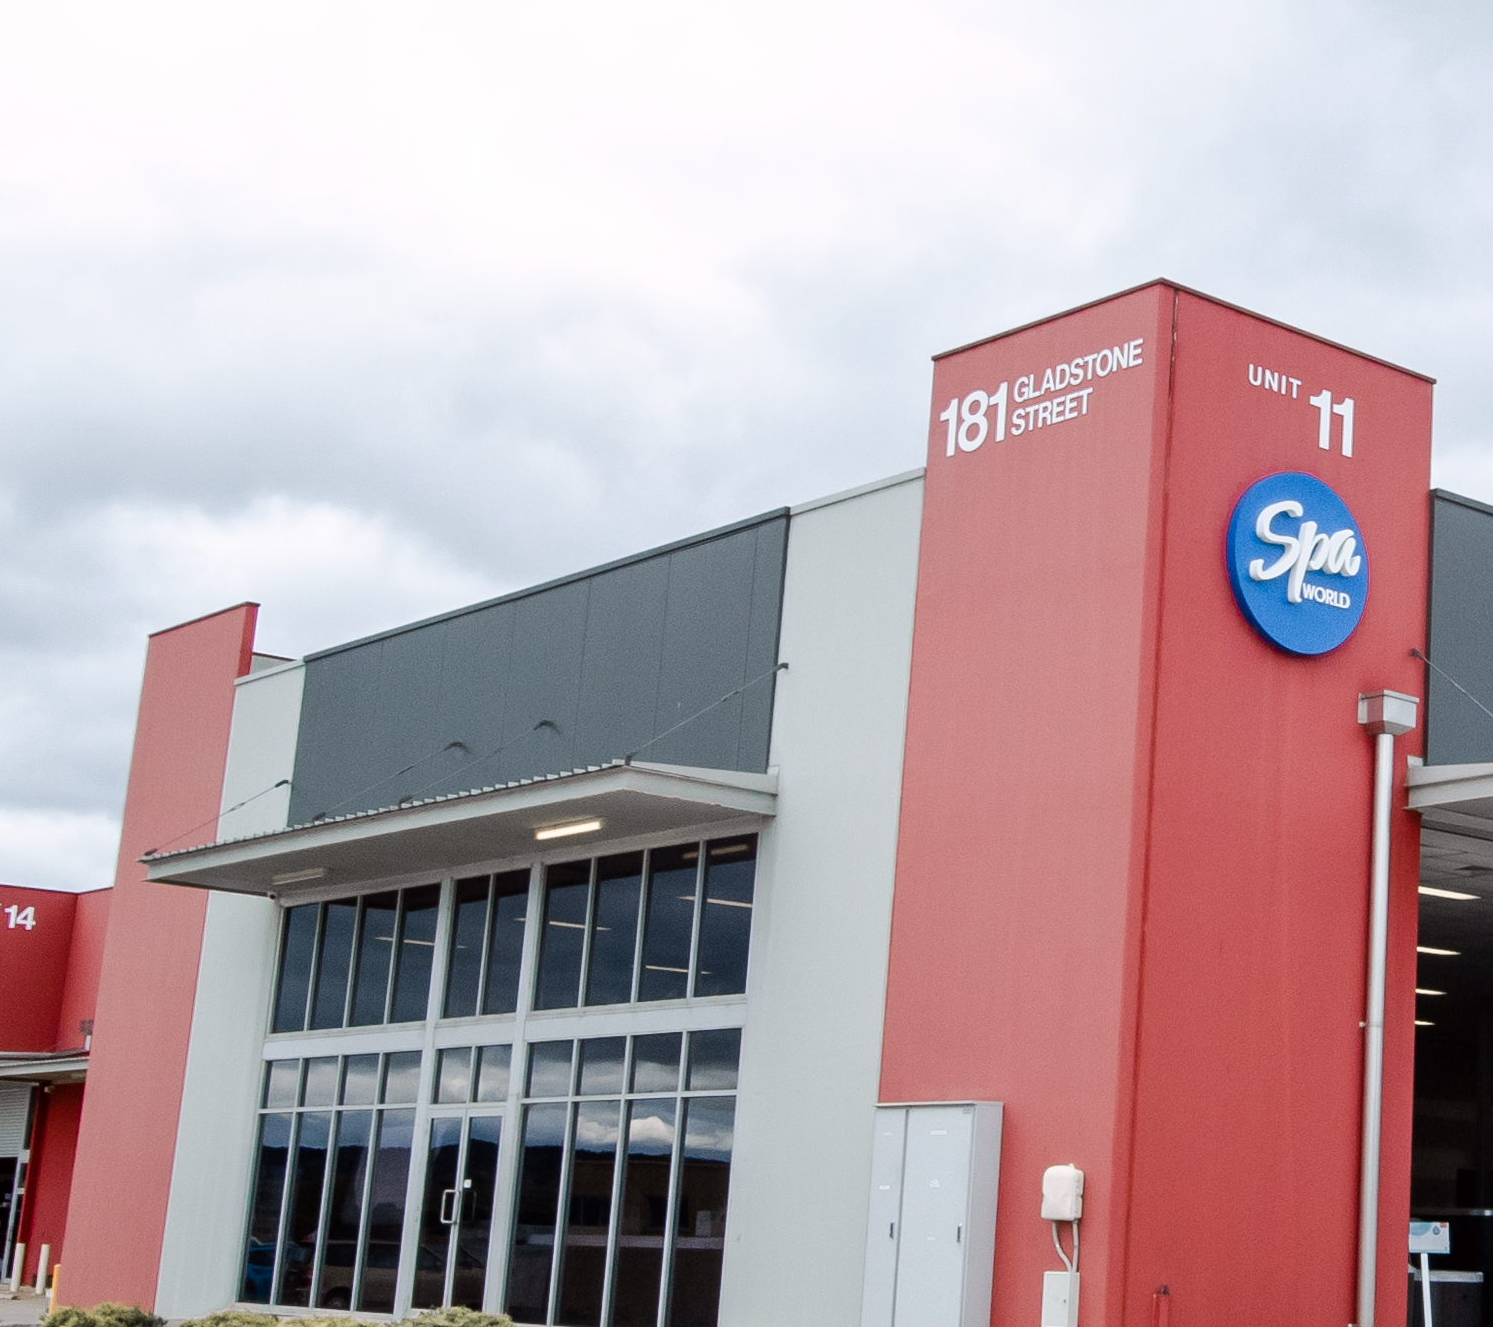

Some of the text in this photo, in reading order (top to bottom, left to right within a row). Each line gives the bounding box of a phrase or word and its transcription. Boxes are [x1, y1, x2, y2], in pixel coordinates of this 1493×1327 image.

[940, 338, 1144, 457] 181 GLADSTONE
[1010, 387, 1094, 436] STREET
[1248, 363, 1355, 458] UNIT 11
[1249, 500, 1361, 604] Spa
[1302, 582, 1351, 609] WORLD
[4, 904, 37, 931] 14
